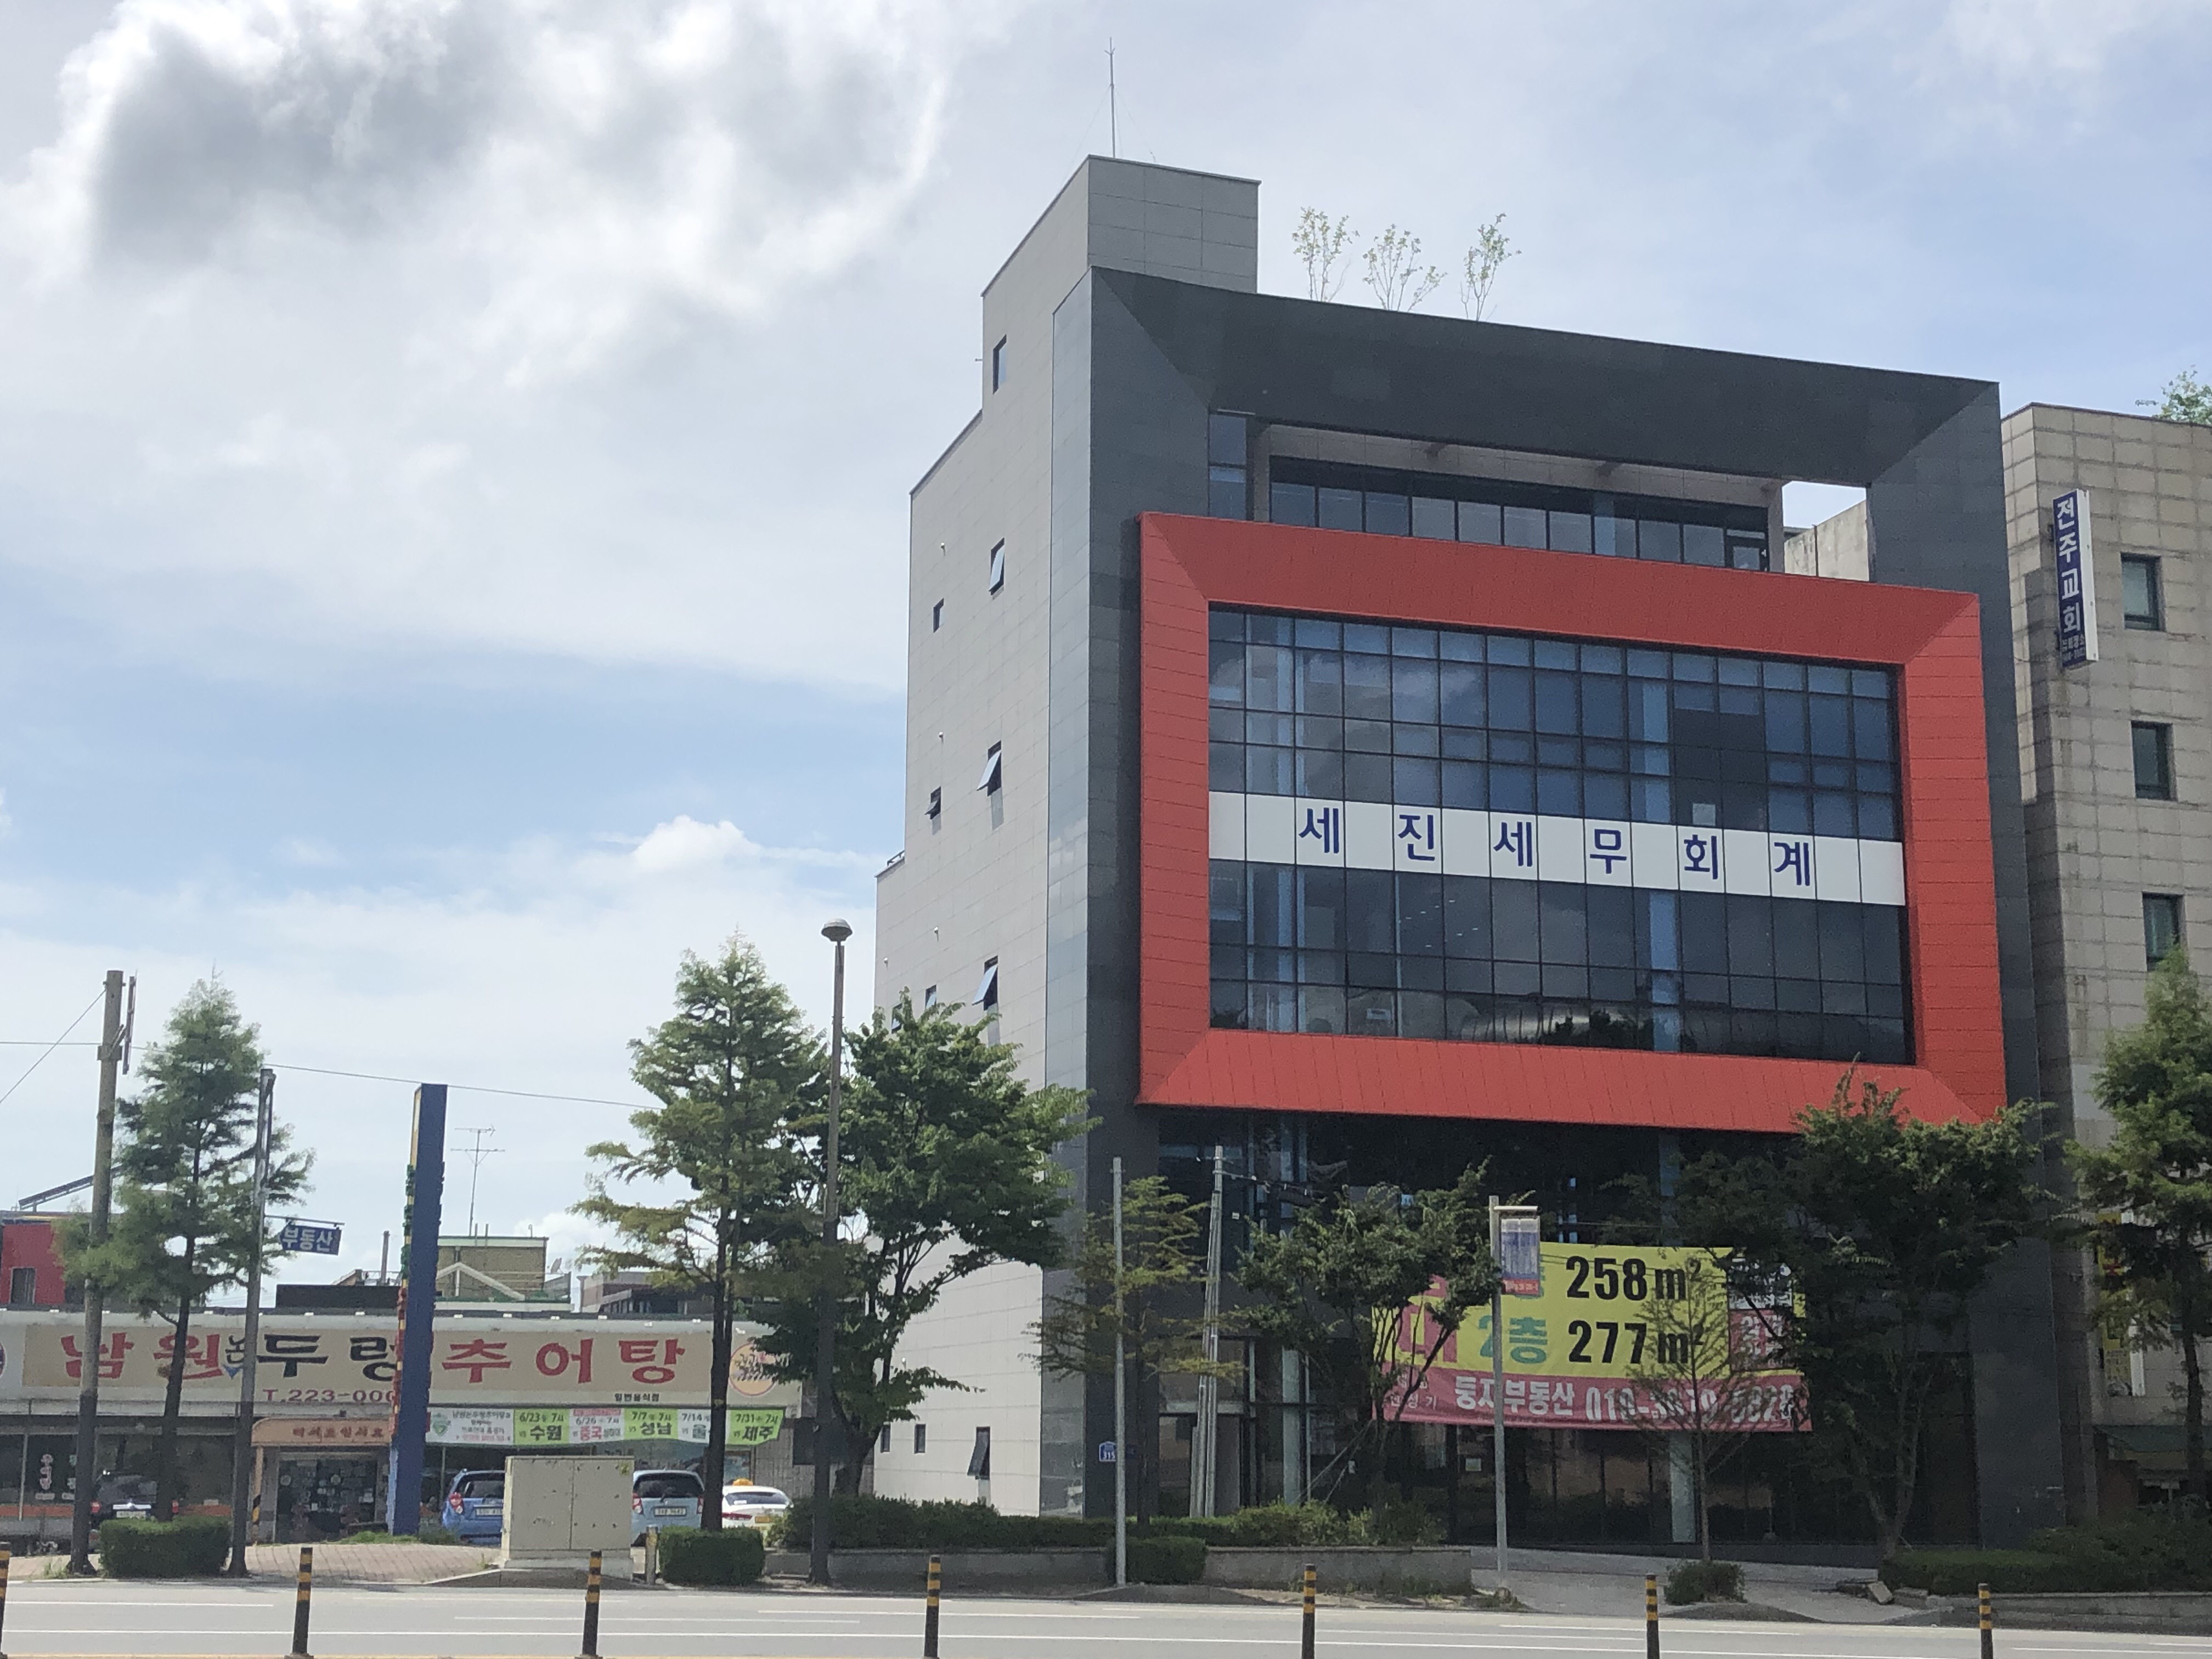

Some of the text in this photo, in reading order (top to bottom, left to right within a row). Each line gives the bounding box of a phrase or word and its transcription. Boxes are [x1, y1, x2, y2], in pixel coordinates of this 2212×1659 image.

[2057, 497, 2081, 633] 전주교회
[282, 1226, 333, 1252] 부동산
[442, 1338, 686, 1384] 추어탕
[530, 1425, 562, 1441] 수원
[640, 1421, 672, 1436] 성남
[742, 1426, 774, 1441] 제주
